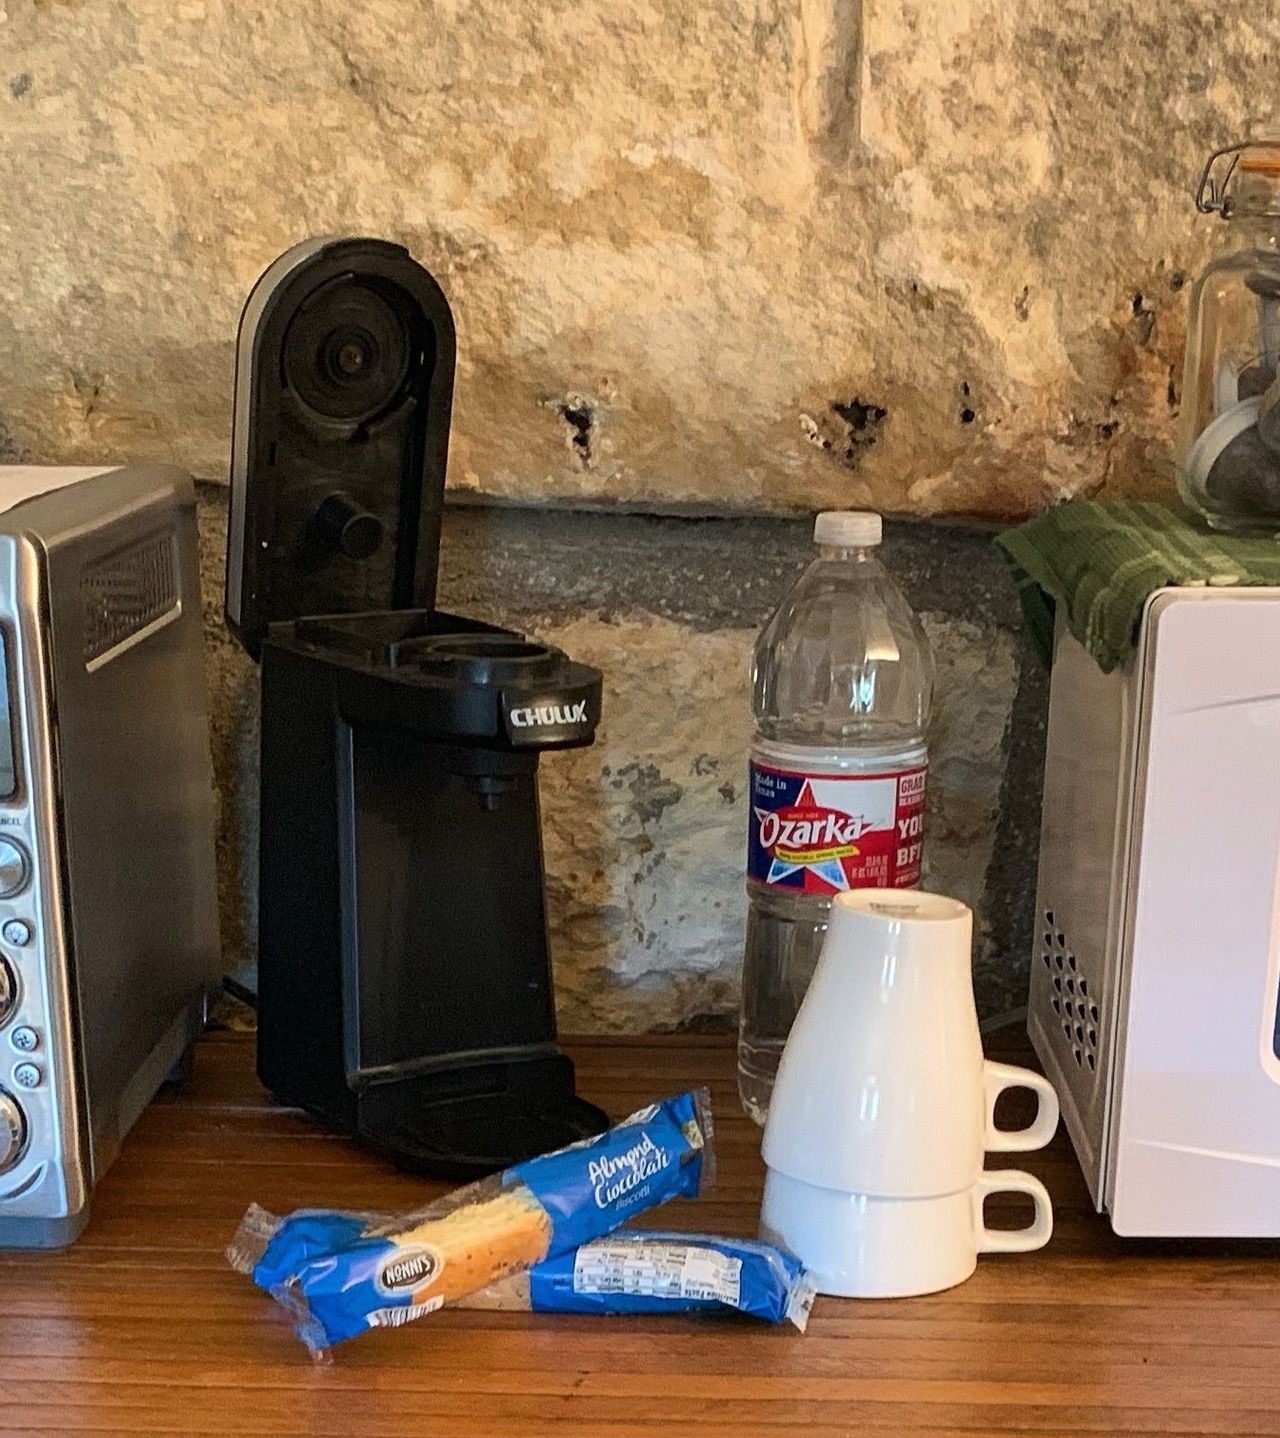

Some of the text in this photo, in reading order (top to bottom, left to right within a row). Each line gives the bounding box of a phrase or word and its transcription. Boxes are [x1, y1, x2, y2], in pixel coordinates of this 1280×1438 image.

[510, 699, 588, 728] CHULUX
[759, 812, 864, 849] Ozarka
[588, 1131, 656, 1186] Almond
[594, 1146, 671, 1209] Cioccolati
